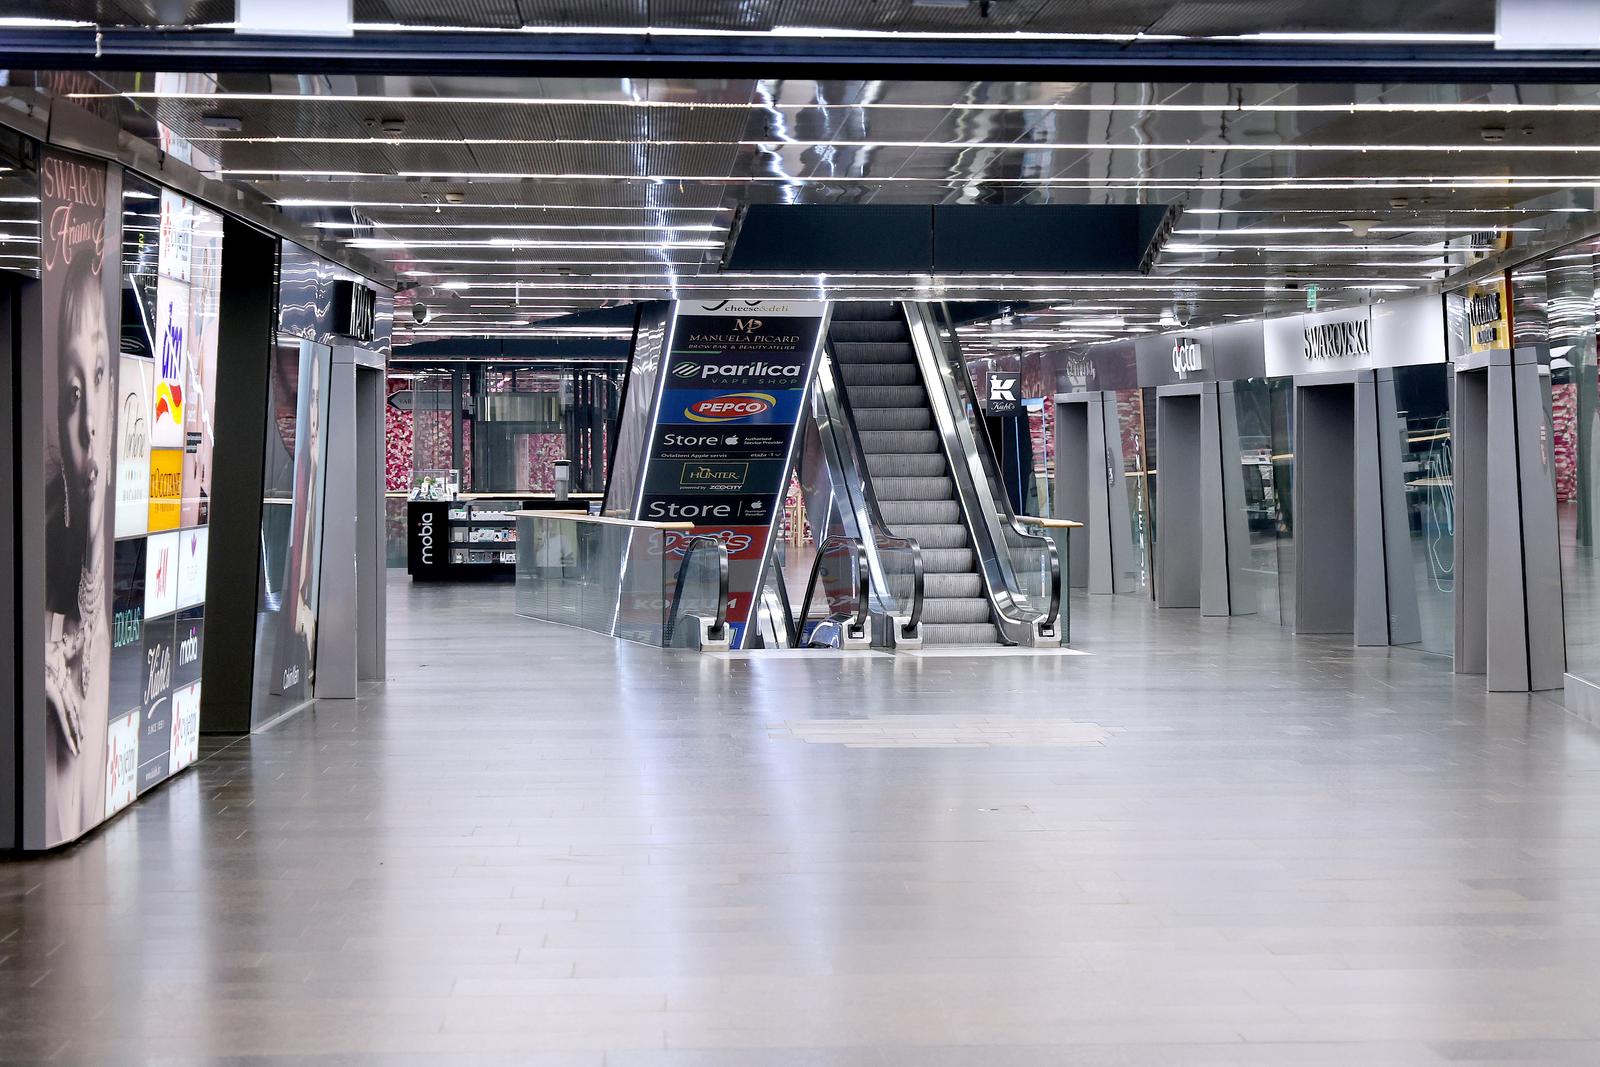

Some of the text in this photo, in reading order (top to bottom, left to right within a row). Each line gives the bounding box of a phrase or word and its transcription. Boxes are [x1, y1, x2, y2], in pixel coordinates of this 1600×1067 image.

[689, 334, 801, 343] MANUELA PICARD
[1303, 319, 1371, 360] SWAROVSKI
[698, 402, 762, 413] PEPCO
[663, 433, 719, 446] Store
[690, 468, 739, 480] HUNTER
[648, 501, 731, 518] Store
[418, 512, 433, 565] mobia
[114, 606, 141, 647] DOUGLAS
[179, 627, 198, 666] mobia
